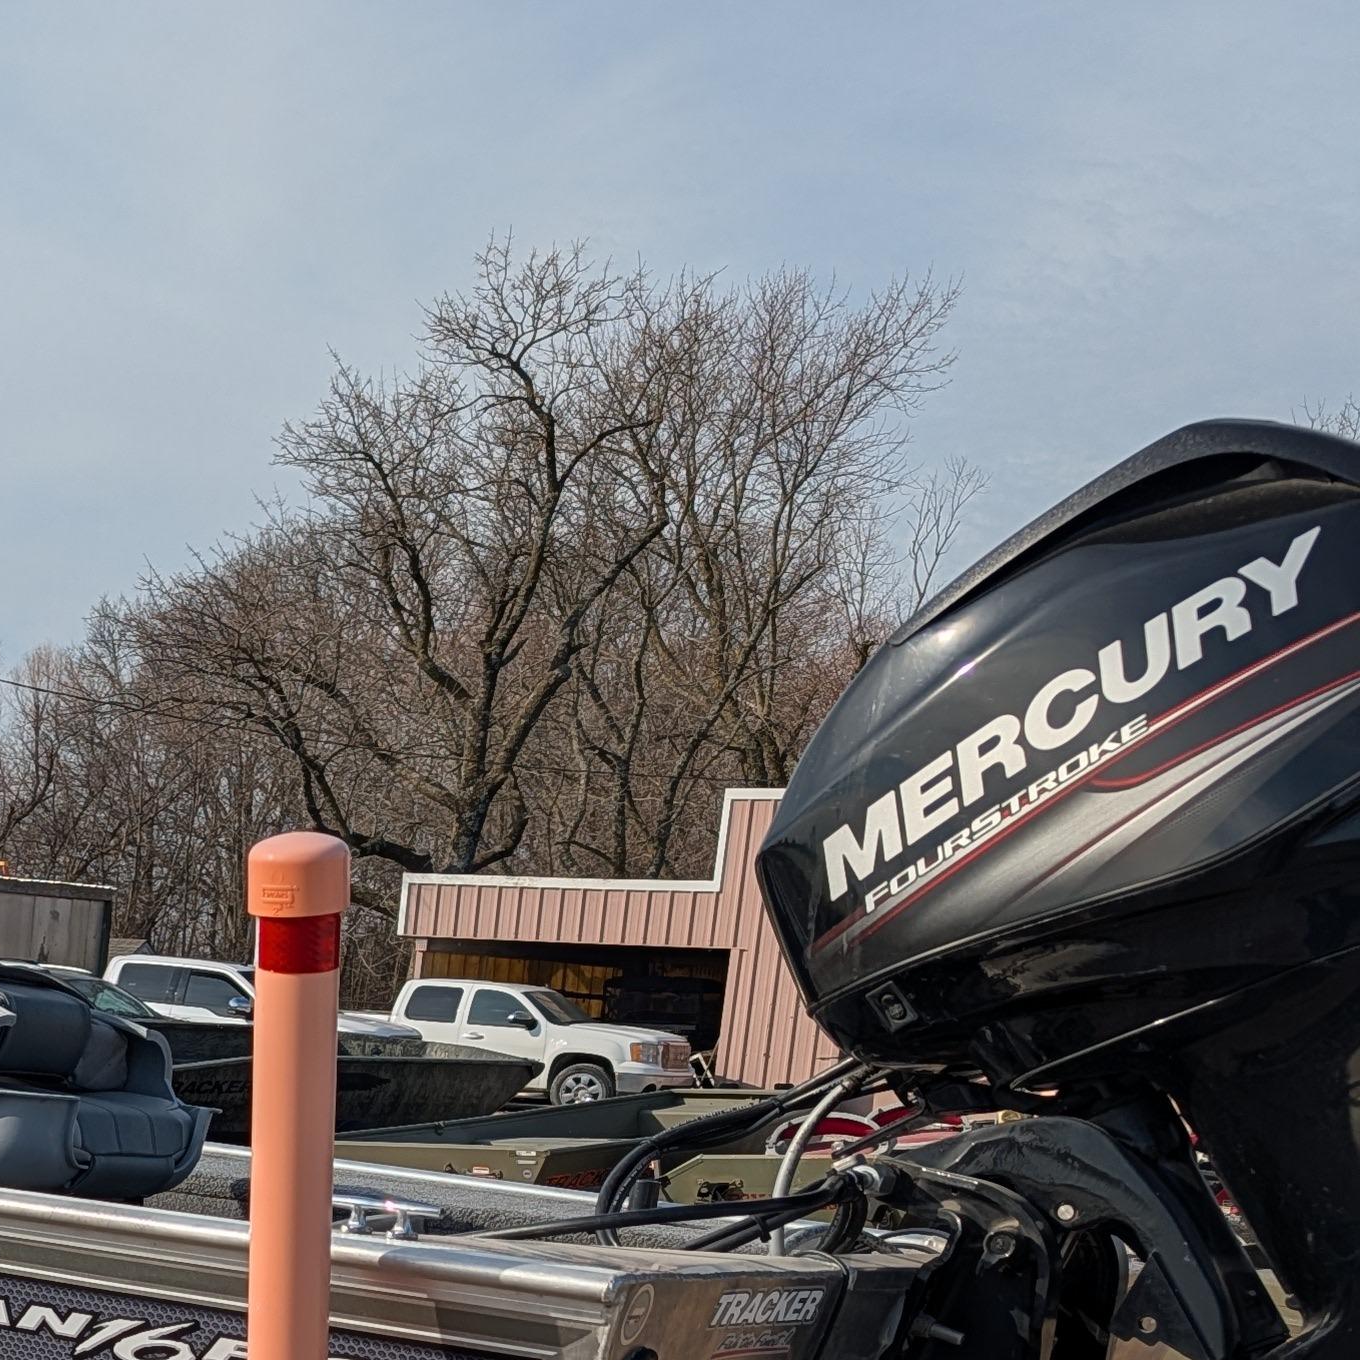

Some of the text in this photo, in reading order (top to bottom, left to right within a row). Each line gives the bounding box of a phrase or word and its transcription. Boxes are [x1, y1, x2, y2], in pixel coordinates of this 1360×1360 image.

[823, 525, 1321, 902] MERCURY
[864, 713, 1153, 914] FOURSTROKE
[710, 1290, 825, 1326] TRACKER
